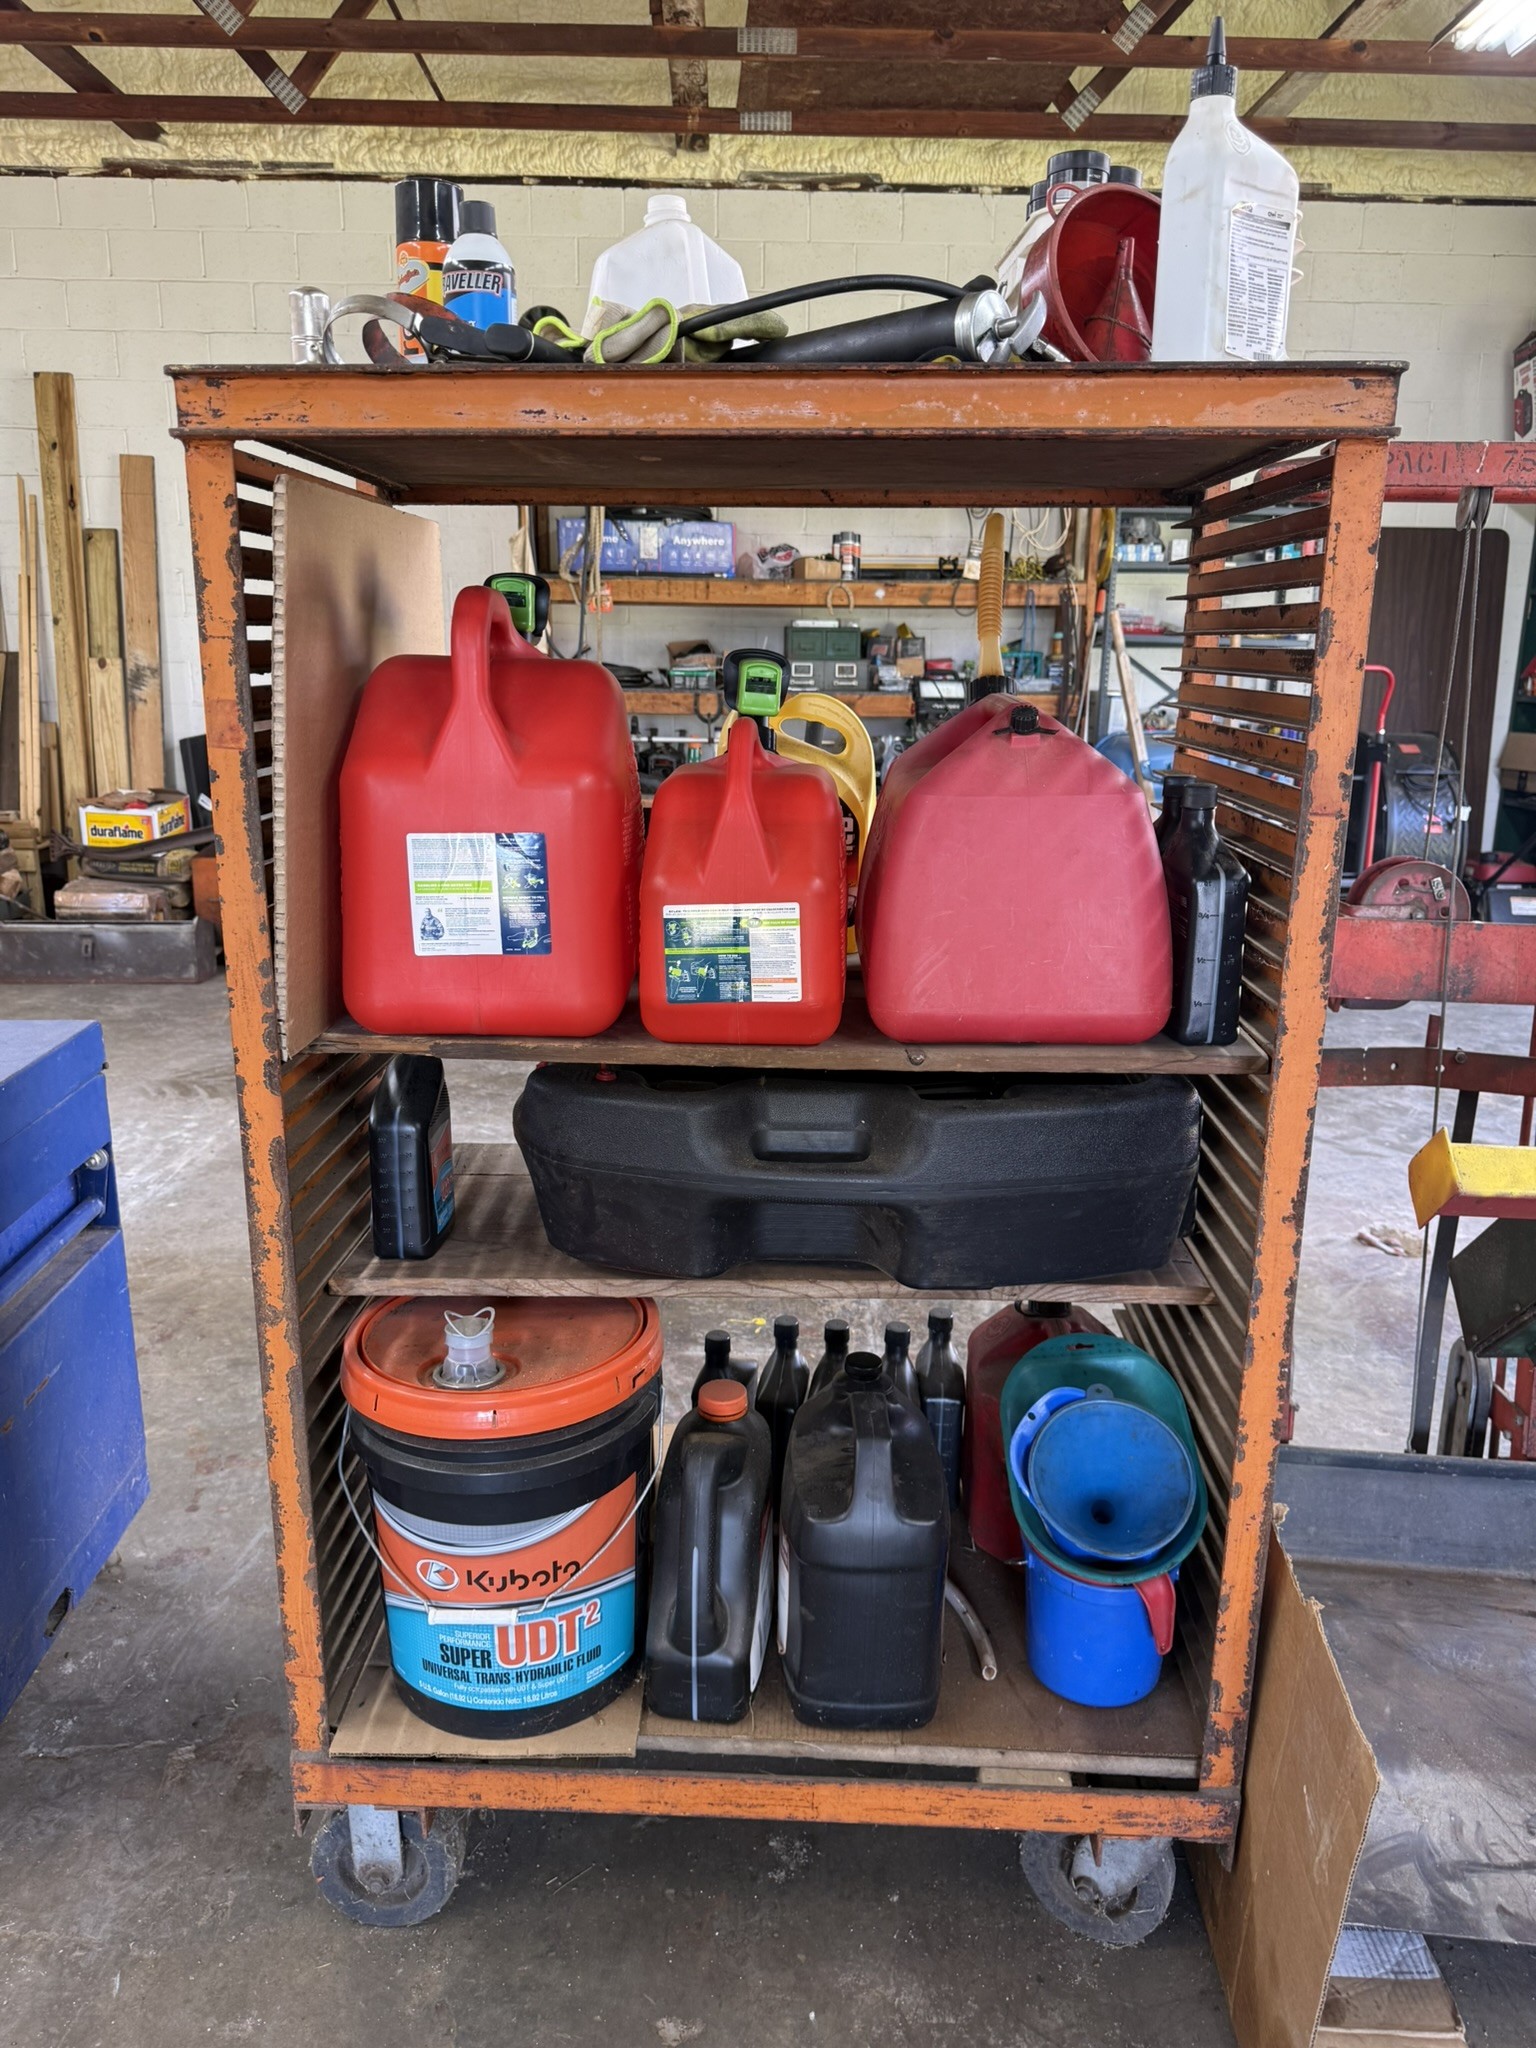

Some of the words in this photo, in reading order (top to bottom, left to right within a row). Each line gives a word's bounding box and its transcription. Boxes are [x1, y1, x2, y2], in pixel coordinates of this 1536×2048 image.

[443, 272, 502, 295] AVELLER
[673, 535, 726, 547] Anywhere
[90, 824, 144, 839] duraflame
[466, 1560, 581, 1593] Kubota
[438, 1633, 491, 1648] PERFORMANCE
[454, 1630, 491, 1640] SUPERIOR
[422, 1658, 472, 1684] UNIVERSAL
[576, 1644, 602, 1668] FLUID
[439, 1643, 492, 1669] SUPER
[433, 1686, 450, 1698] Gallon
[453, 1683, 468, 1692] Fully
[517, 1684, 530, 1693] UDT
[537, 1681, 556, 1691] Super
[557, 1675, 569, 1684] UDT
